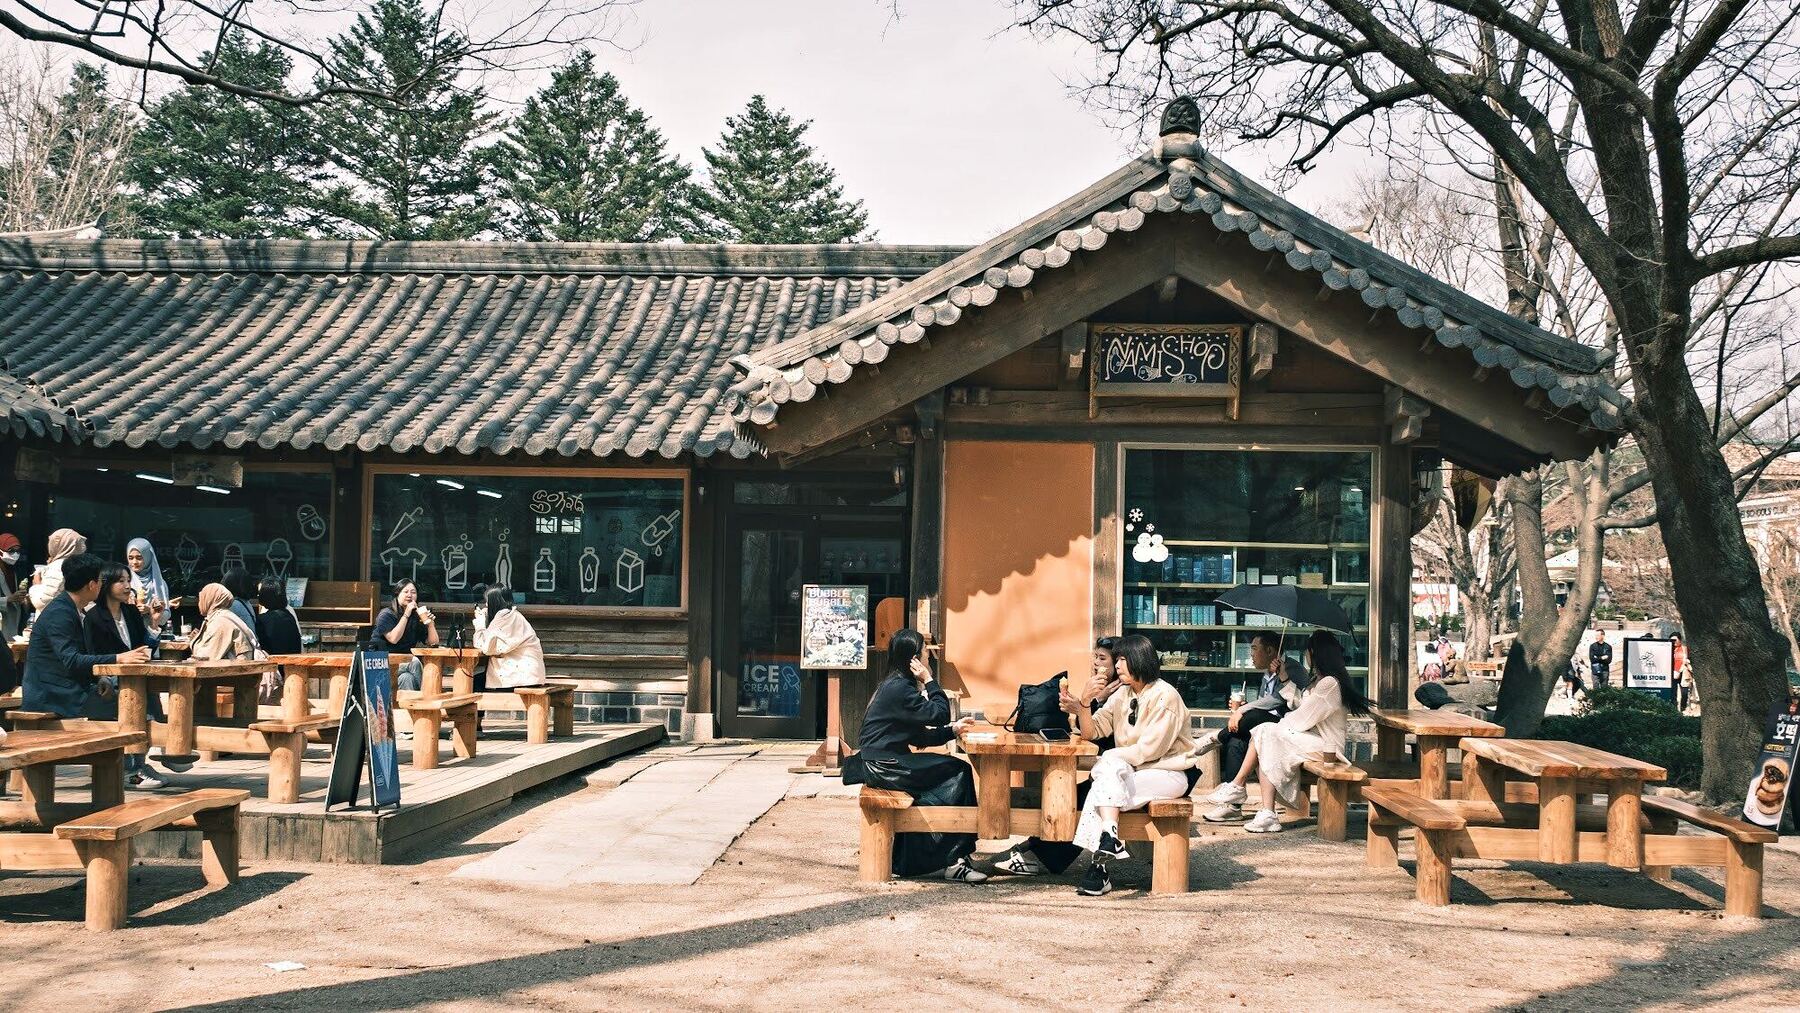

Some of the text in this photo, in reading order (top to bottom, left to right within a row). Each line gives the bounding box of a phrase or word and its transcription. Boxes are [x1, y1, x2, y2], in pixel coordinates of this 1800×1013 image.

[1105, 335, 1225, 380] NAMI SHOP
[809, 589, 851, 597] BUBBLE
[743, 664, 779, 683] ICE
[744, 683, 779, 692] CREAM
[1773, 721, 1798, 744] 호떡
